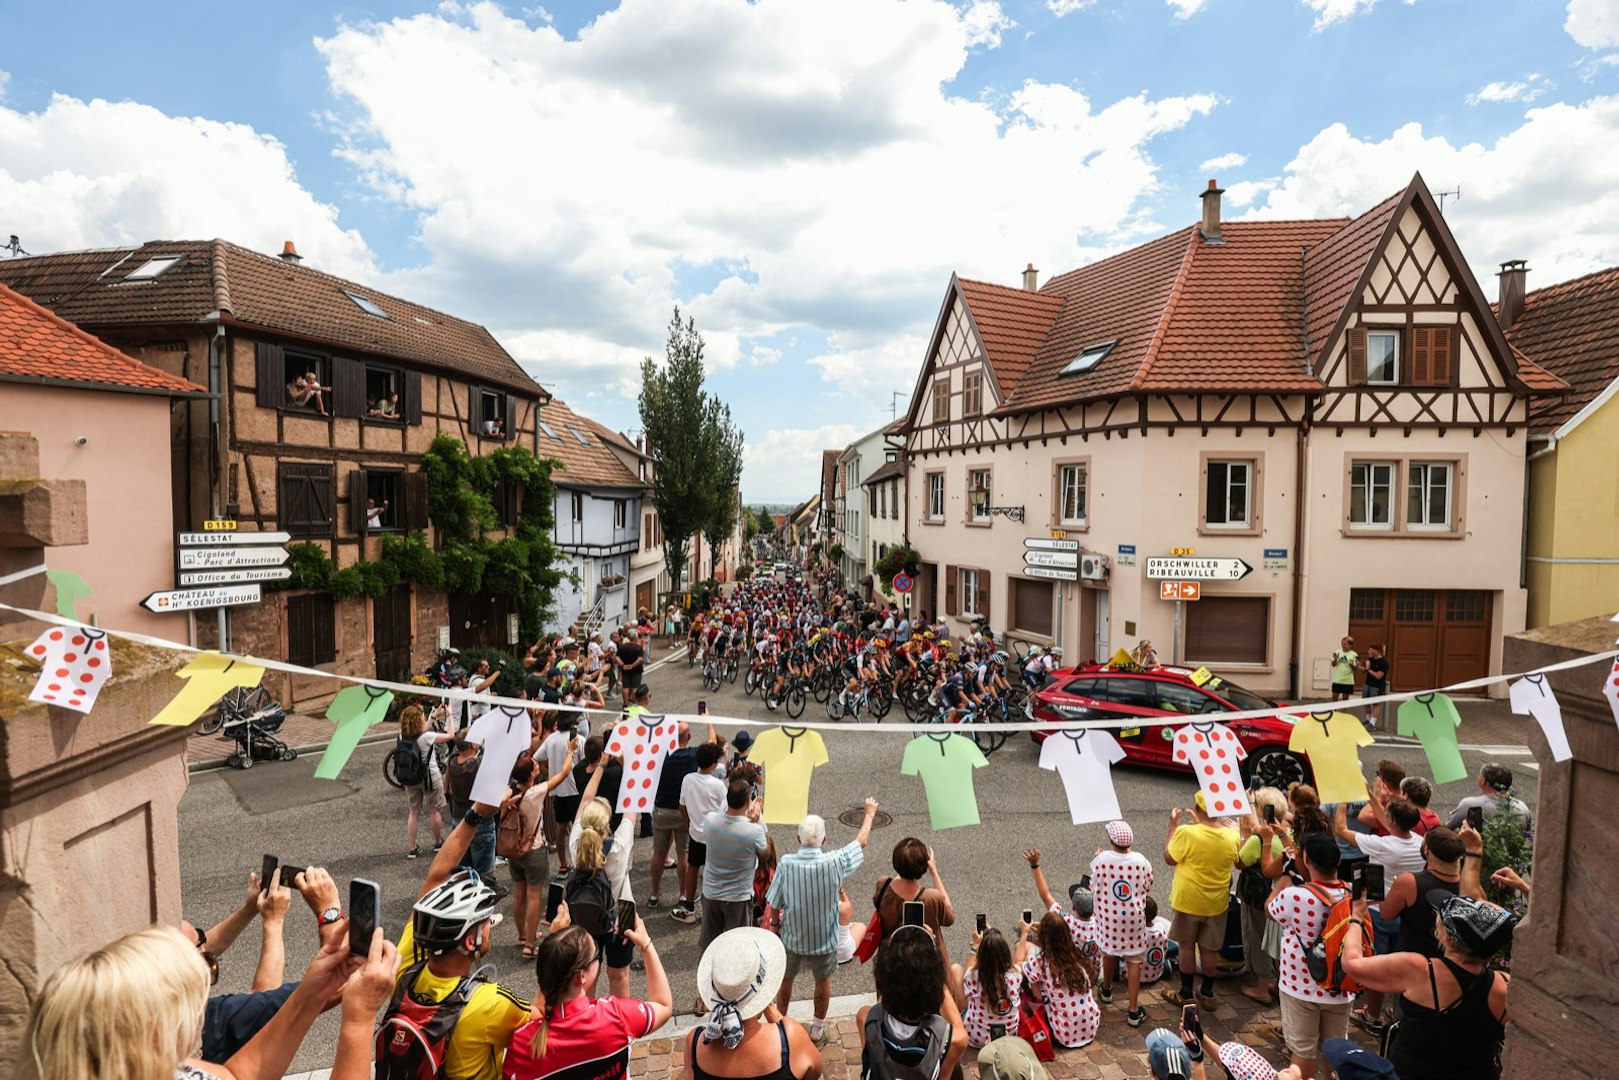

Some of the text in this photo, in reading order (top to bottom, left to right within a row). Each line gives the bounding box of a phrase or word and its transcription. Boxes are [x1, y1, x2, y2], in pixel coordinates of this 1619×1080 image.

[183, 534, 233, 543] SÉLESTAT
[196, 550, 236, 559] Cigoland
[204, 558, 224, 566] Parc
[227, 556, 281, 566] d'Attractions
[1150, 560, 1219, 568] ORSCHWILLER
[197, 571, 283, 583] Office du Tourisme
[1149, 569, 1216, 577] RIBEAUVILLE
[171, 590, 215, 600] CHÂTEAU
[186, 594, 259, 607] KOENIGSBOURG
